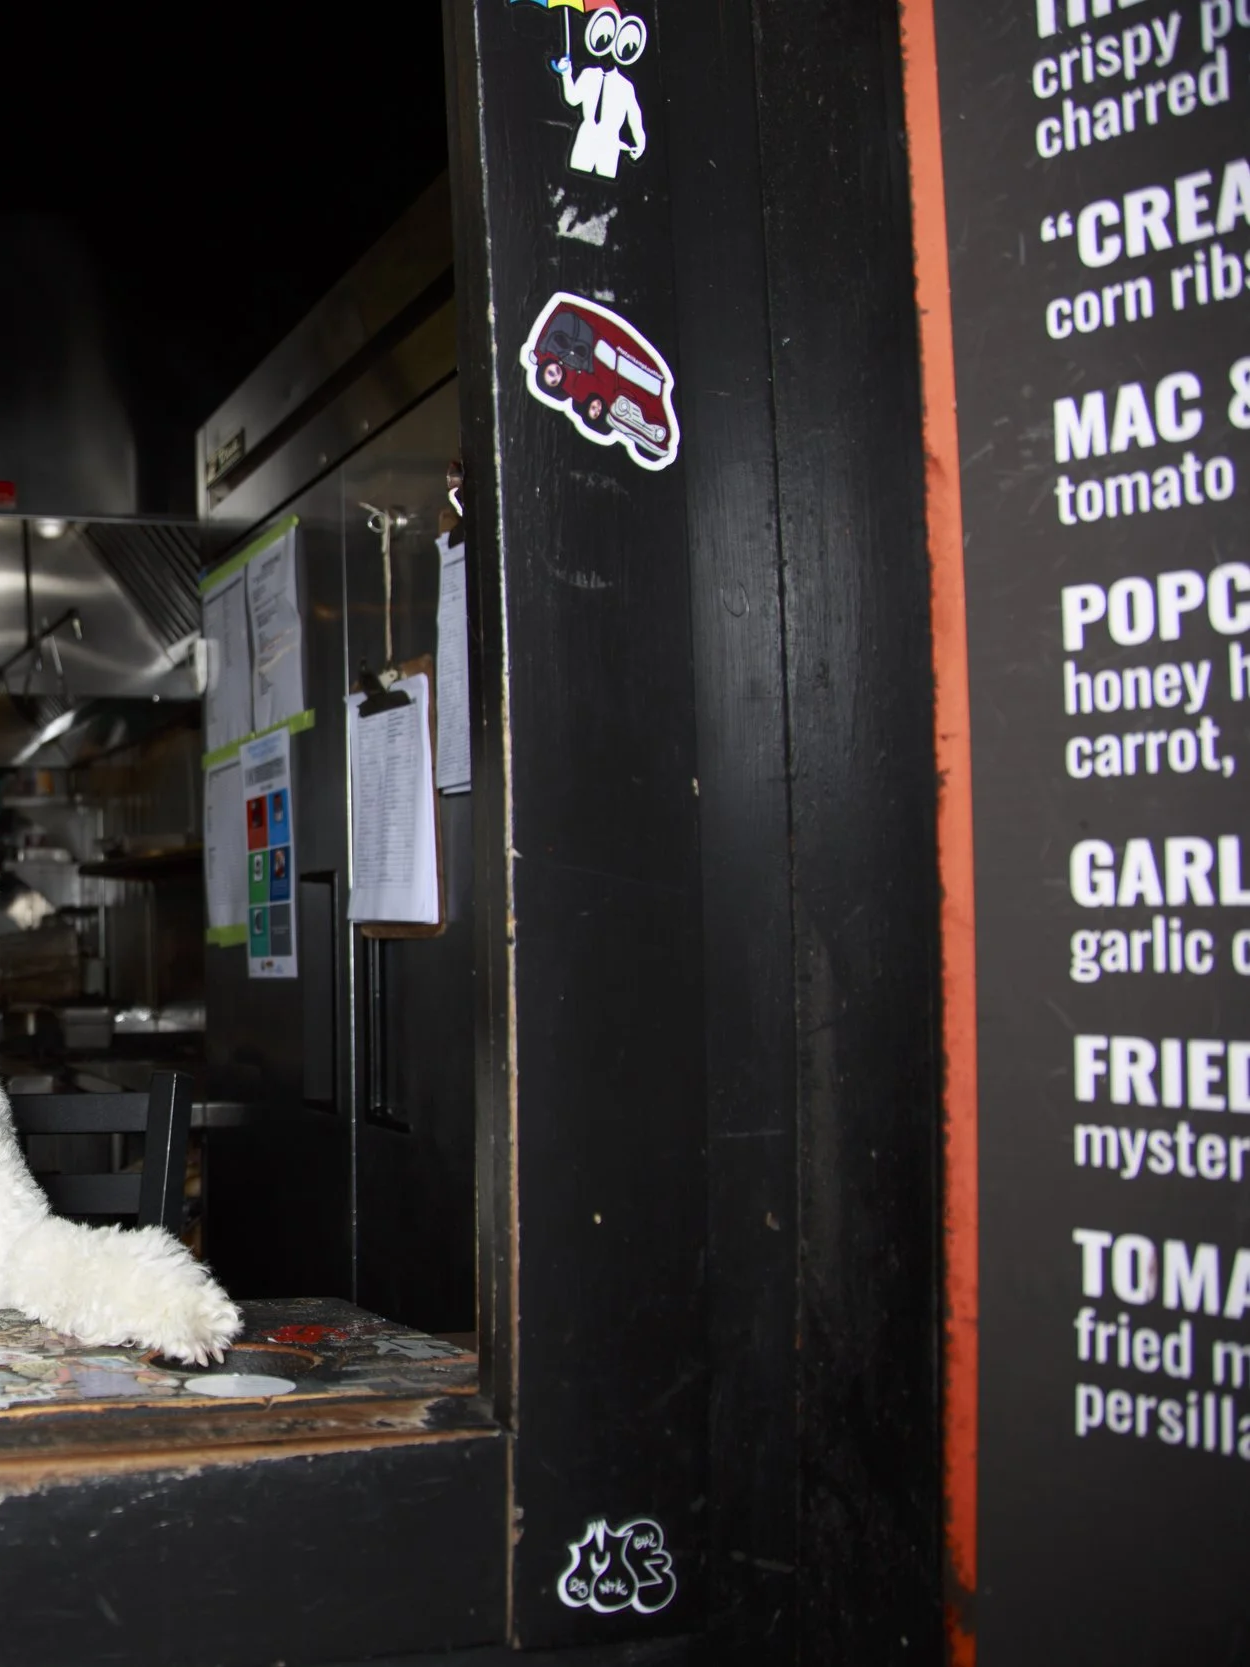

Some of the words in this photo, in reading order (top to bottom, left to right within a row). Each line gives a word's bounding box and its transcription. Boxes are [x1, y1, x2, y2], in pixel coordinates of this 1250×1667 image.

[1033, 13, 1180, 98] crispy
[1036, 48, 1228, 158] charred
[1046, 277, 1152, 339] corn
[1171, 244, 1250, 310] rib
[1054, 372, 1202, 463] MAC
[1054, 452, 1234, 525] tomato
[1062, 563, 1250, 652] POPC
[1064, 660, 1211, 715] honey
[1066, 716, 1234, 778] carrot,
[1070, 835, 1250, 907] GARL
[1070, 915, 1213, 983] garlic
[1075, 1308, 1191, 1377] fried
